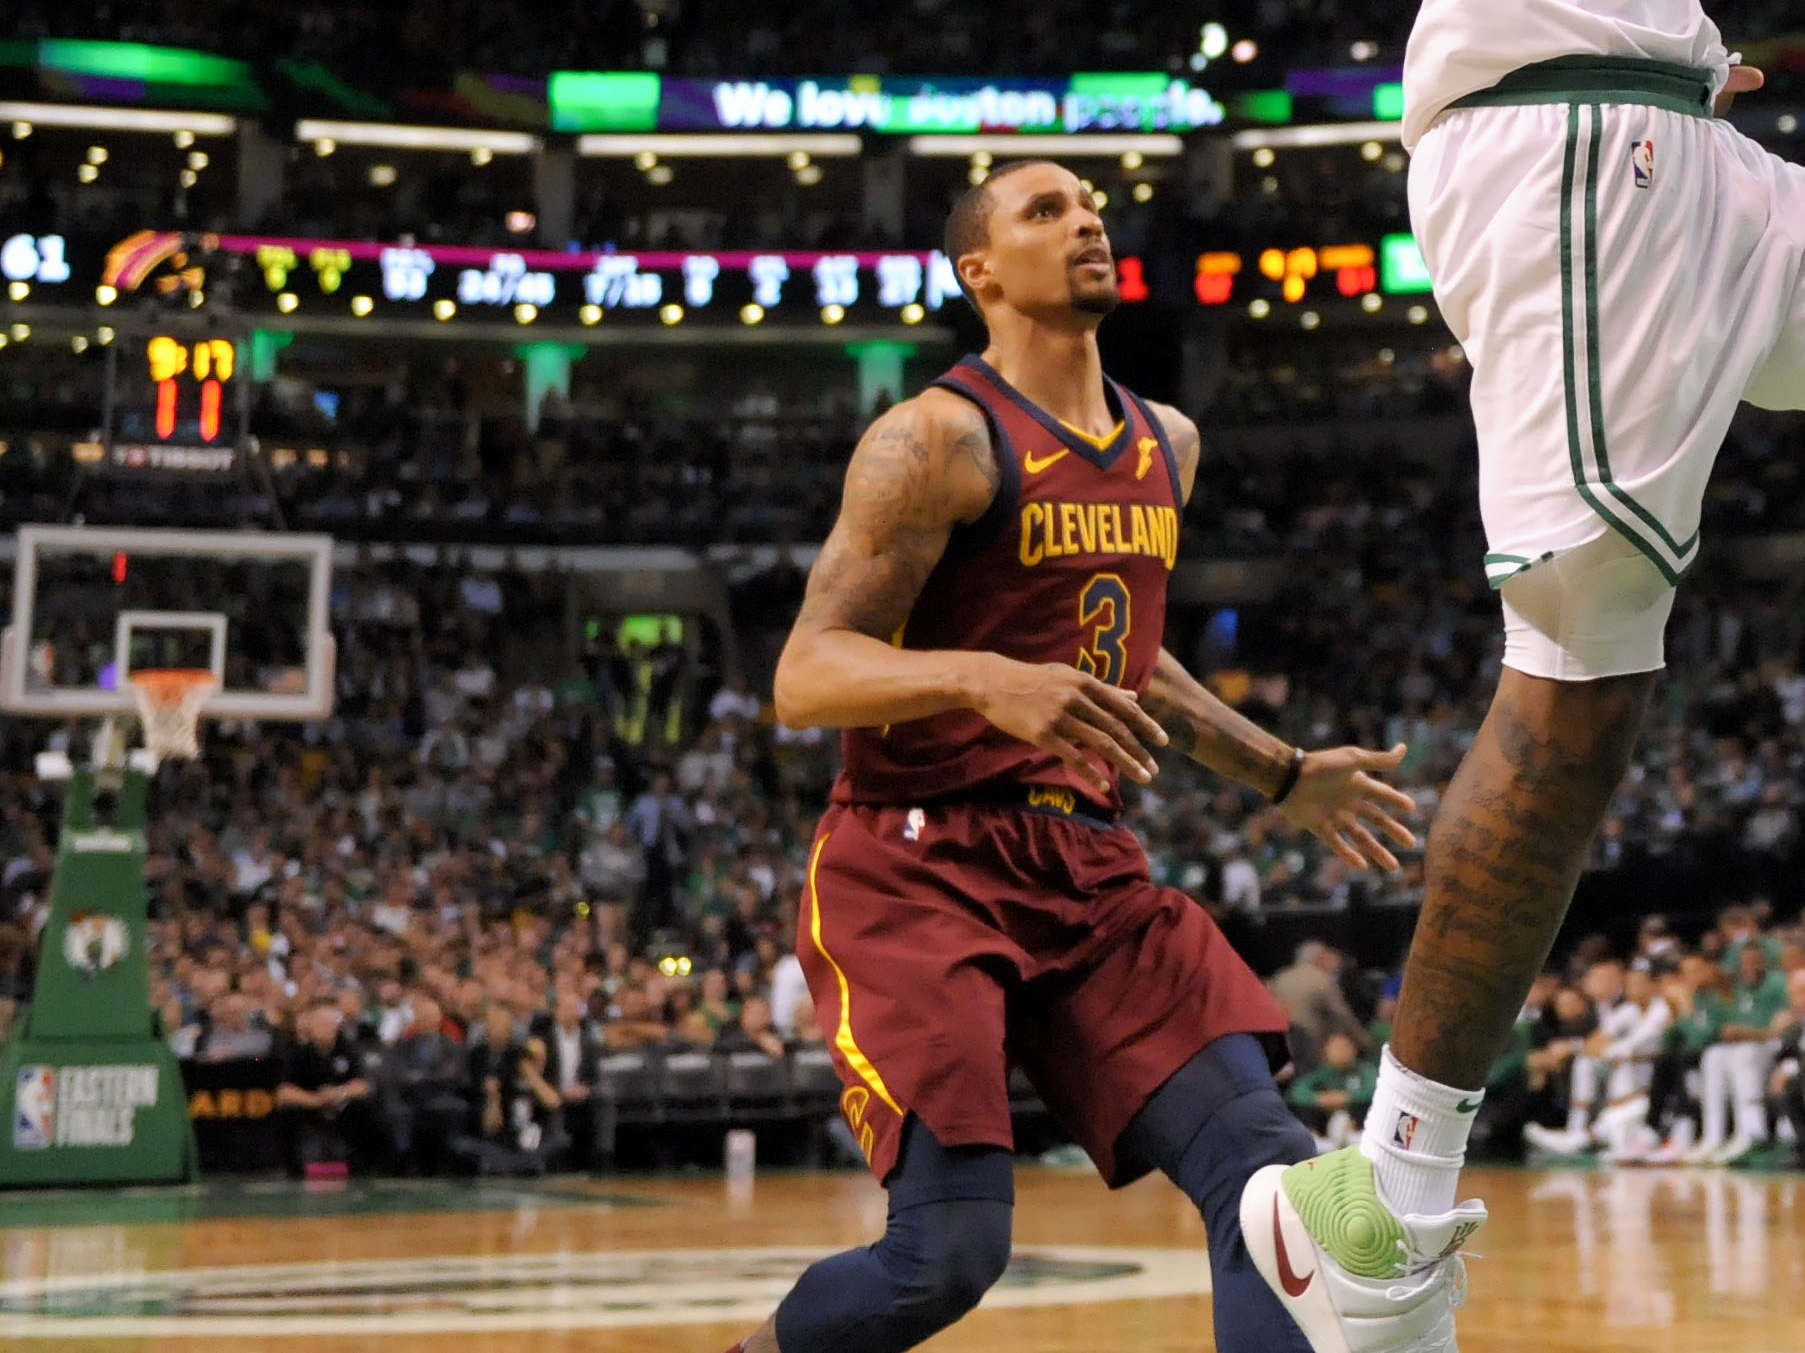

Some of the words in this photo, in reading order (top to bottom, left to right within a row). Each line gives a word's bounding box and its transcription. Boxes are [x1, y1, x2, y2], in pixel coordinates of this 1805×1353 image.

[713, 81, 793, 128] We
[1019, 502, 1180, 571] CLEVELAND
[1076, 573, 1131, 690] 3
